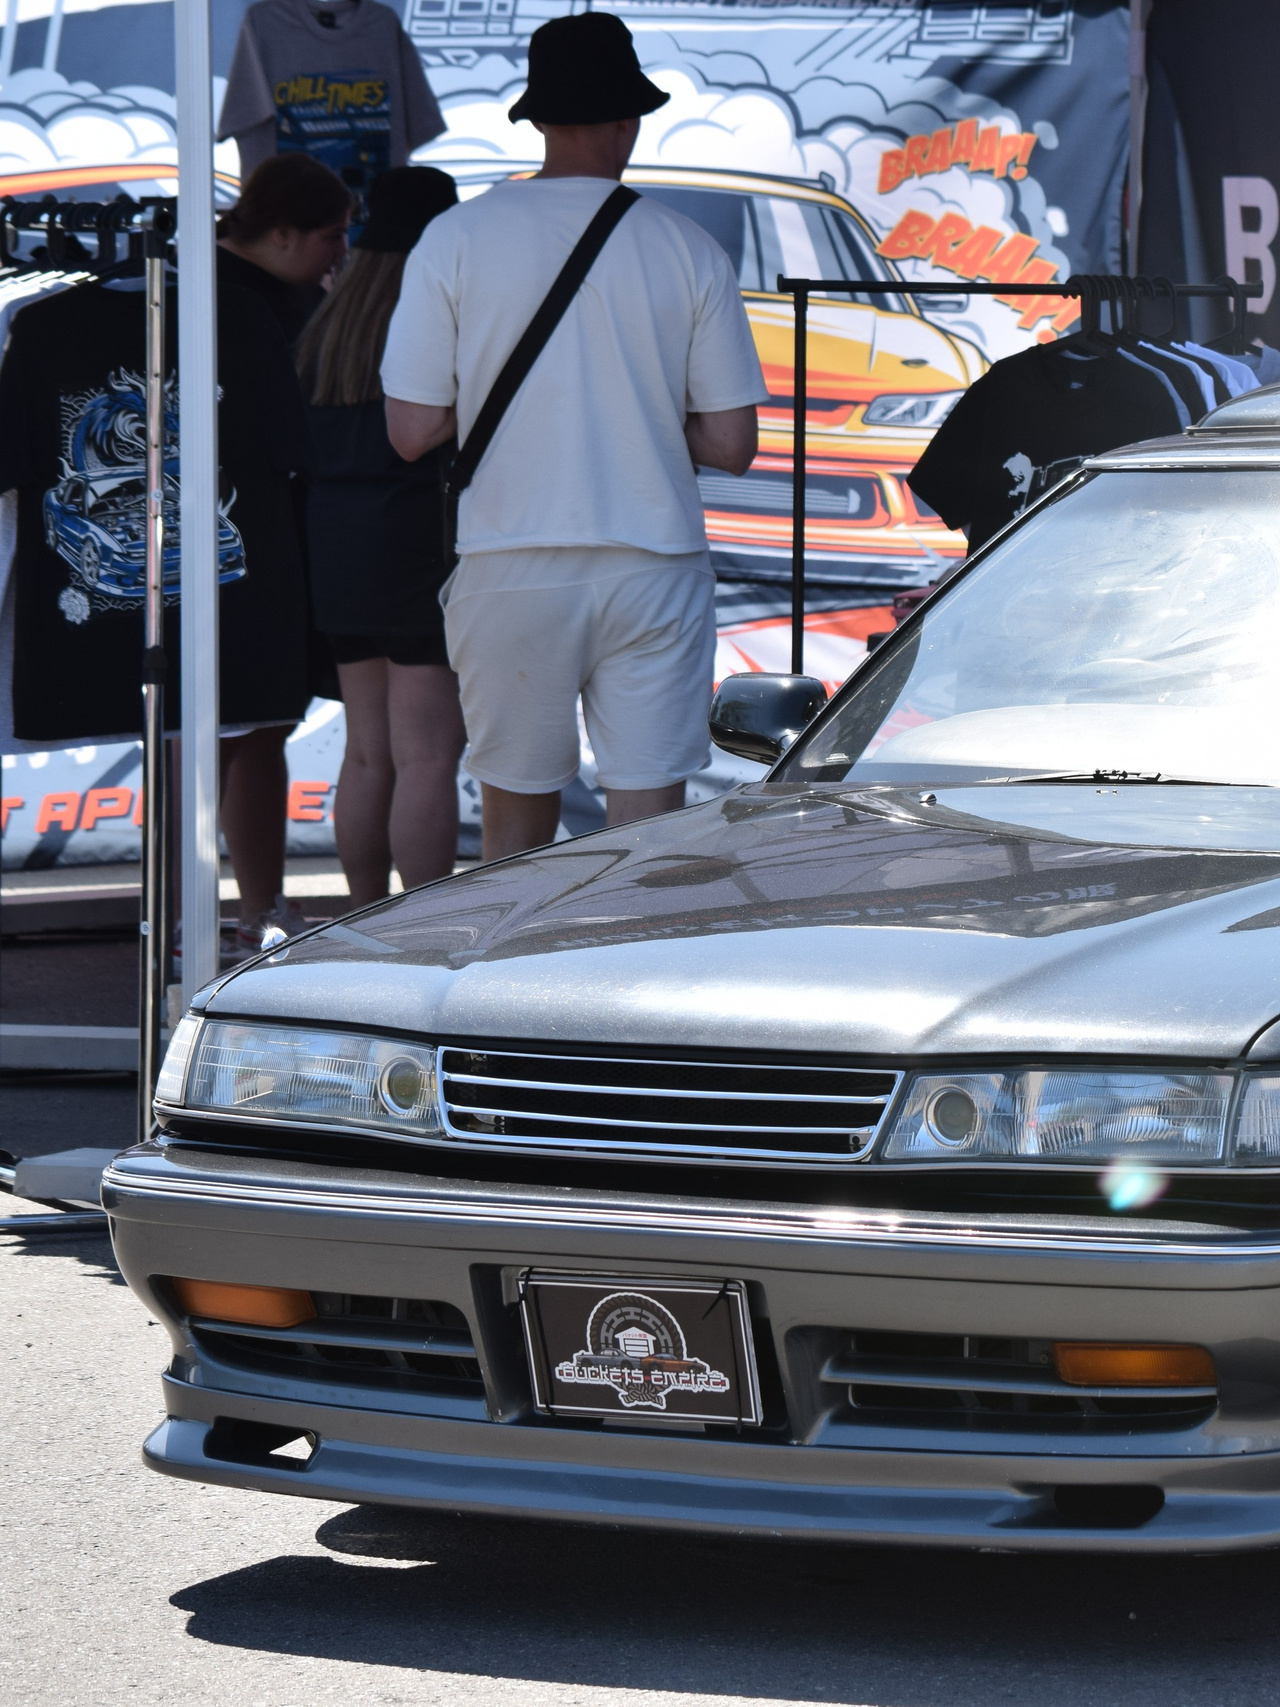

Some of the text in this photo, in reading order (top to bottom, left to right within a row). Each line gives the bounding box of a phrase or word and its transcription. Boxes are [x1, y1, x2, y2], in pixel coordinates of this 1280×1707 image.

[273, 75, 385, 114] CHILL TIMES
[877, 117, 1038, 195] BRAAAP!
